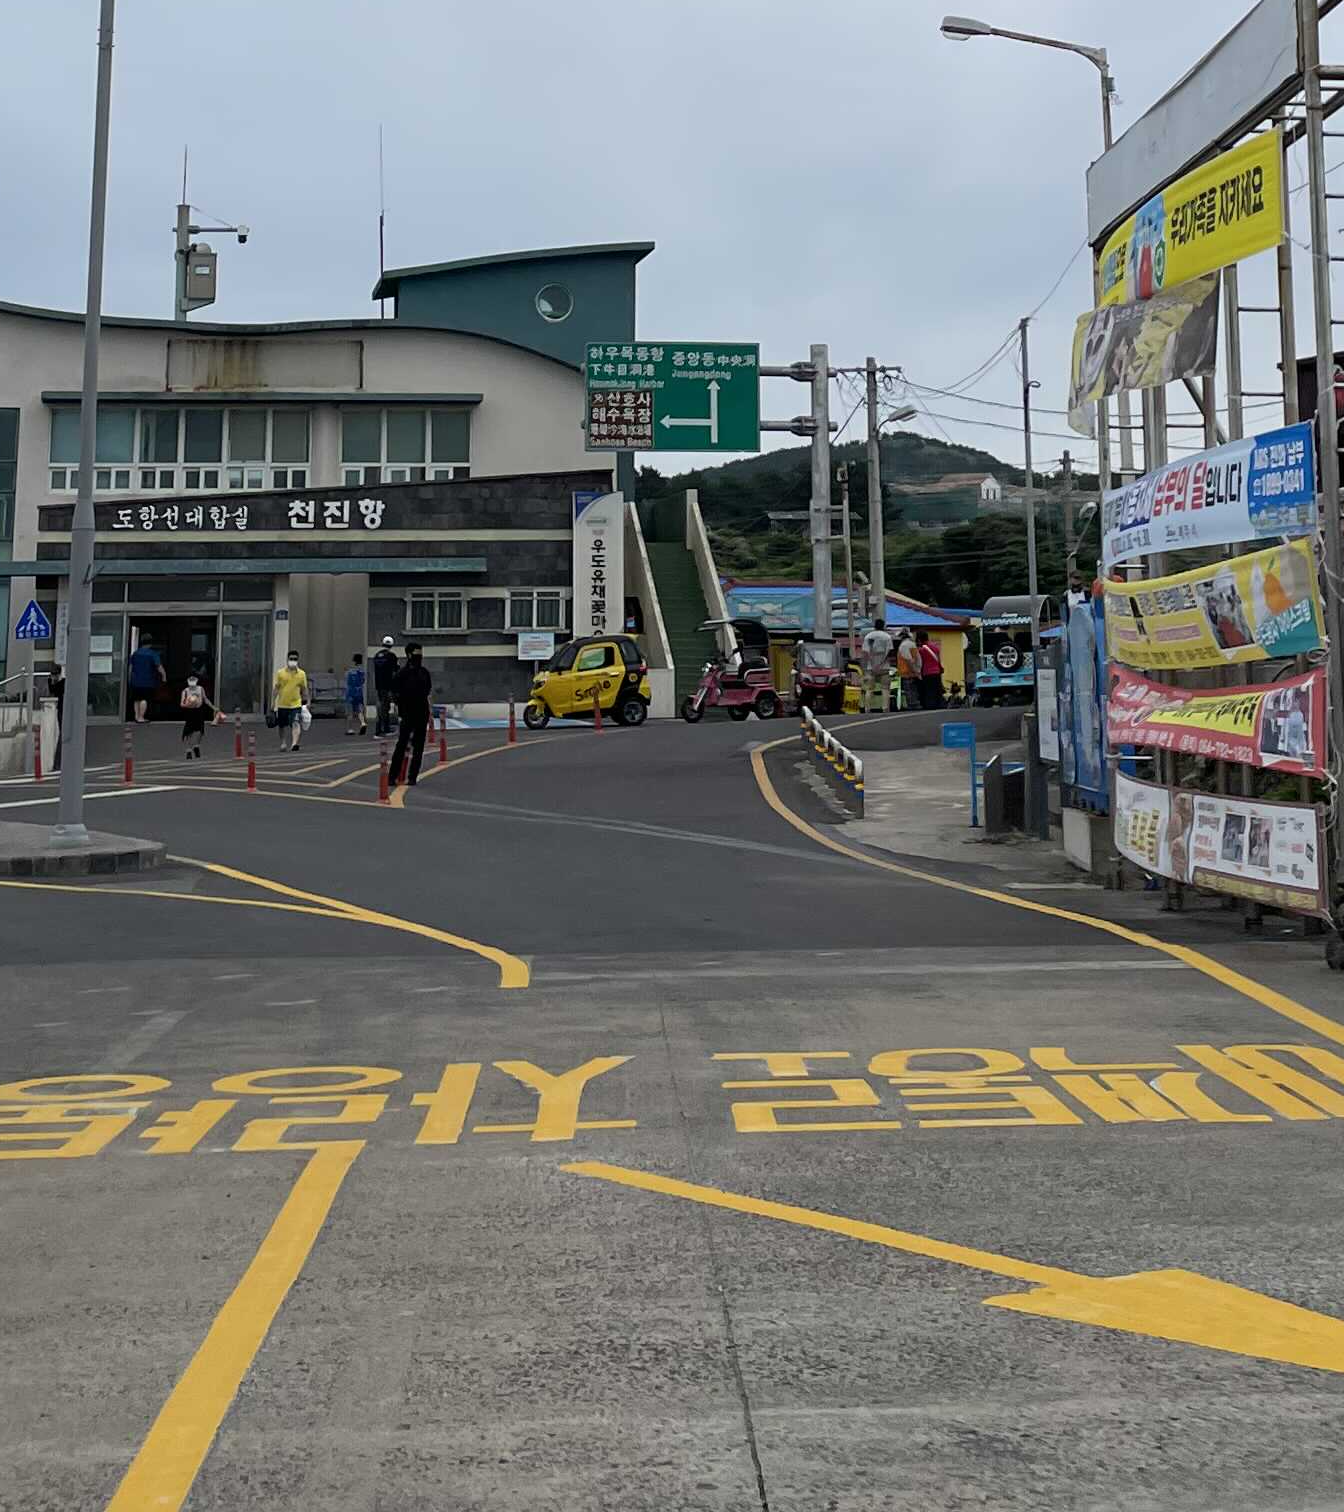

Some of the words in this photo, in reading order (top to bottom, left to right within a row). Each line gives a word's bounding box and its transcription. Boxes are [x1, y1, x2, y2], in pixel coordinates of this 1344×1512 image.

[1218, 165, 1264, 226] 지키세요
[590, 346, 665, 362] 하우목동항
[671, 351, 716, 367] 중앙동
[607, 391, 651, 407] 산호사
[592, 407, 652, 424] 해수욕장
[1191, 459, 1242, 510] 달입니다
[287, 498, 386, 530] 천진항
